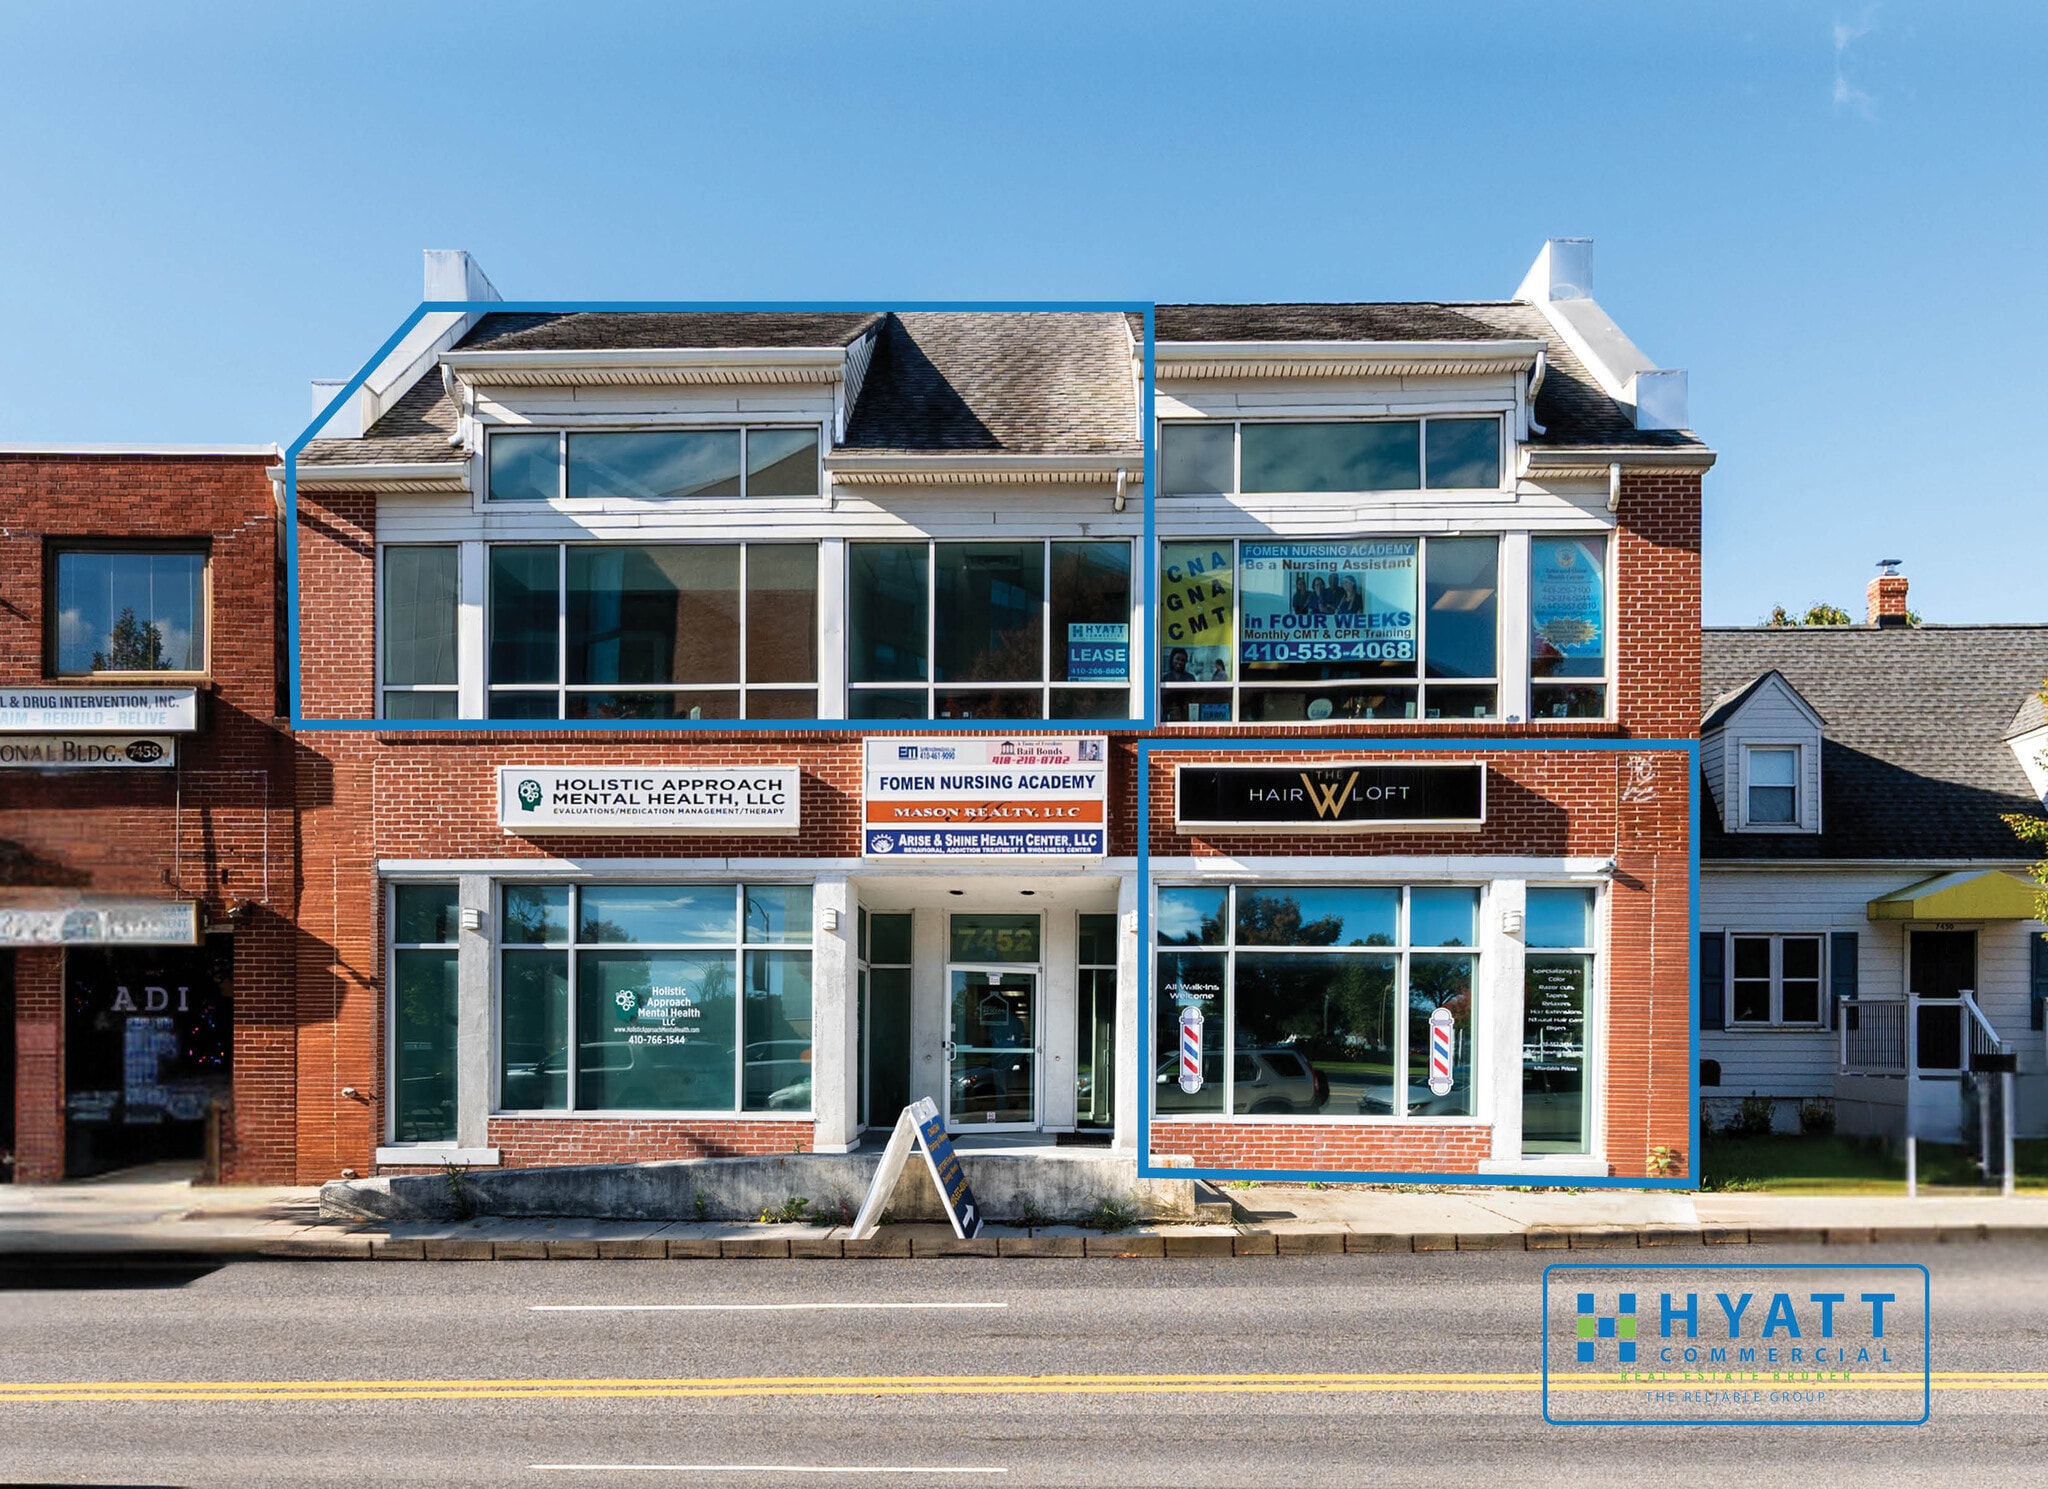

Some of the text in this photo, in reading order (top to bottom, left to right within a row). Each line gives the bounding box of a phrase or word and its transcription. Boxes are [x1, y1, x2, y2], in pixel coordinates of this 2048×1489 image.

[1245, 544, 1411, 557] FOMEN NURSING ACADEMY
[1245, 558, 1412, 572] Be a Nursing Assistant
[1245, 612, 1411, 628] in FOUR WEEKS
[1086, 625, 1124, 633] HYATT
[1244, 628, 1411, 641] Monthly CMT & CPR Training
[1071, 649, 1126, 662] LEASE
[1244, 642, 1412, 660] 410-553-4068
[10, 696, 20, 708] &
[23, 696, 57, 708] DRUG
[60, 695, 152, 709] INTERVENTION,
[155, 695, 180, 708] INC.
[43, 712, 104, 725] REBUILD
[118, 712, 166, 725] RELIVE
[62, 741, 122, 762] BLDG.
[129, 745, 160, 758] 7458
[1316, 770, 1343, 780] THE
[556, 779, 783, 790] HOLISTIC APPROACH
[880, 775, 1096, 790] FOMEN NURSING ACADEMY
[553, 793, 785, 806] MENTAL HEALTH, LLC
[1250, 771, 1410, 819] HAIR W LOFT
[554, 807, 785, 815] EVALUATIONS/MEDICATION MANAGEMENT/THERAPY
[894, 808, 959, 817] MASON
[1043, 808, 1080, 817] LLC
[899, 833, 1097, 847] ARISE & SHINE HEALTH CENTER, LLC
[958, 929, 1032, 952] 7452
[652, 987, 687, 996] Holistic
[110, 986, 189, 1012] ADI
[647, 998, 691, 1008] Approach
[638, 1008, 700, 1017] Mental Health
[629, 1035, 685, 1044] 410-766-1544
